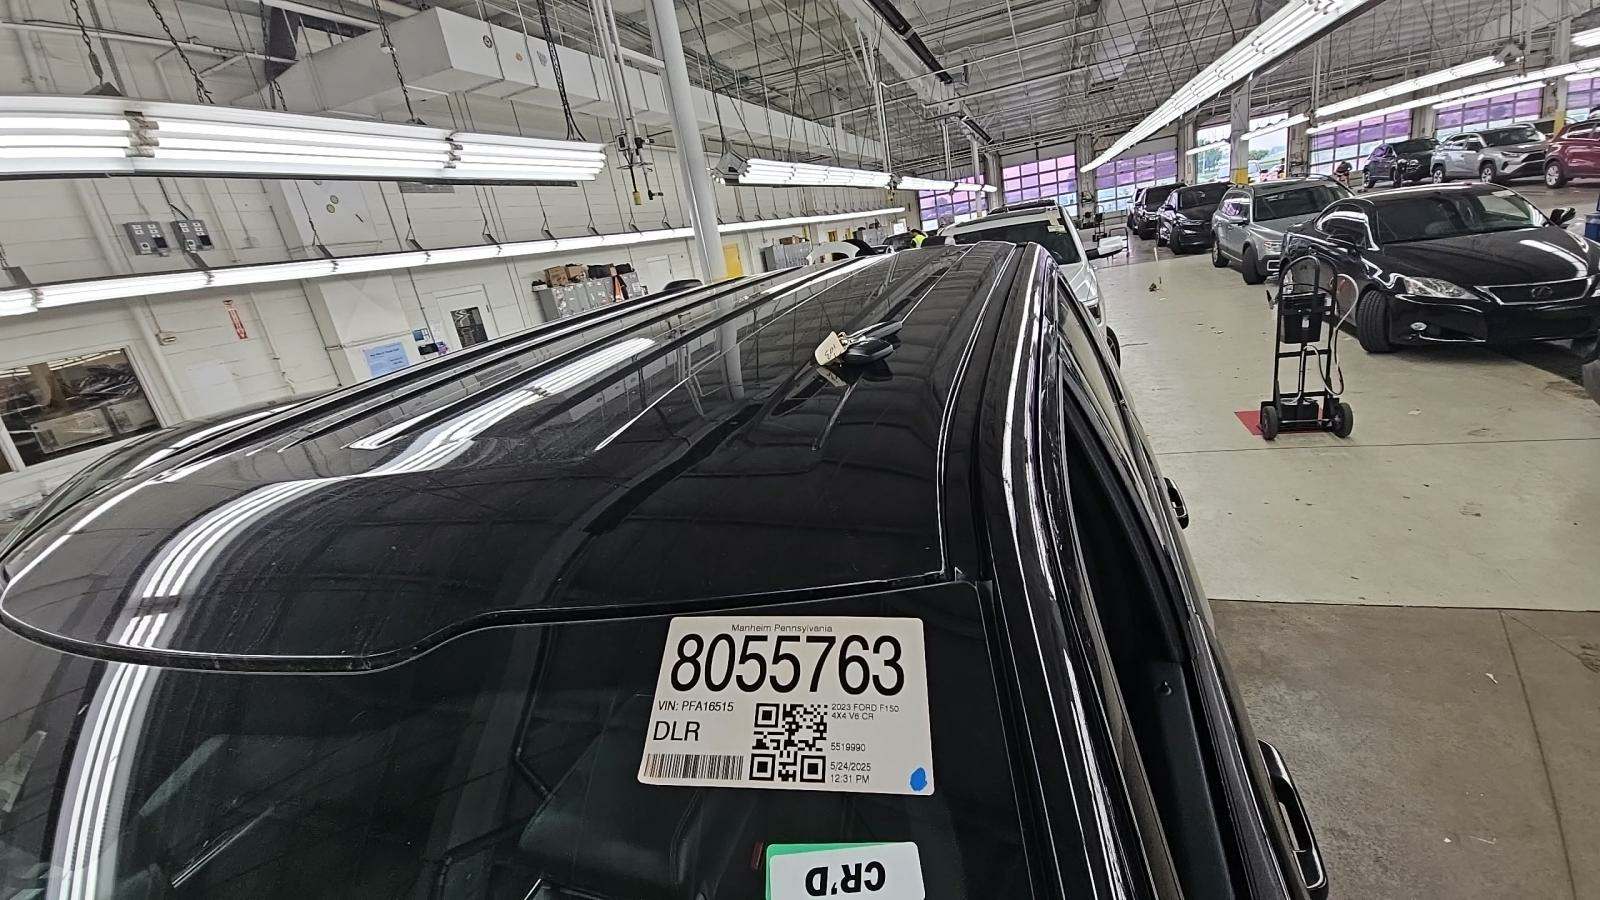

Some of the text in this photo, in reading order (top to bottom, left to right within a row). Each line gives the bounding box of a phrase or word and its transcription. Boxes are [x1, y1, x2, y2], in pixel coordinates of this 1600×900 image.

[731, 624, 833, 633] Manheim Pennsylvania
[671, 633, 905, 696] 8055763
[658, 700, 734, 712] VIN: PFA16515
[831, 703, 900, 713] 2023 FORD F150
[849, 712, 860, 720] V6
[861, 712, 874, 720] CR
[653, 720, 700, 741] DLR
[830, 742, 866, 752] 5519990
[830, 761, 872, 772] 5/24/2025
[831, 774, 870, 784] 12:31 PM
[805, 861, 886, 897] CR'D
